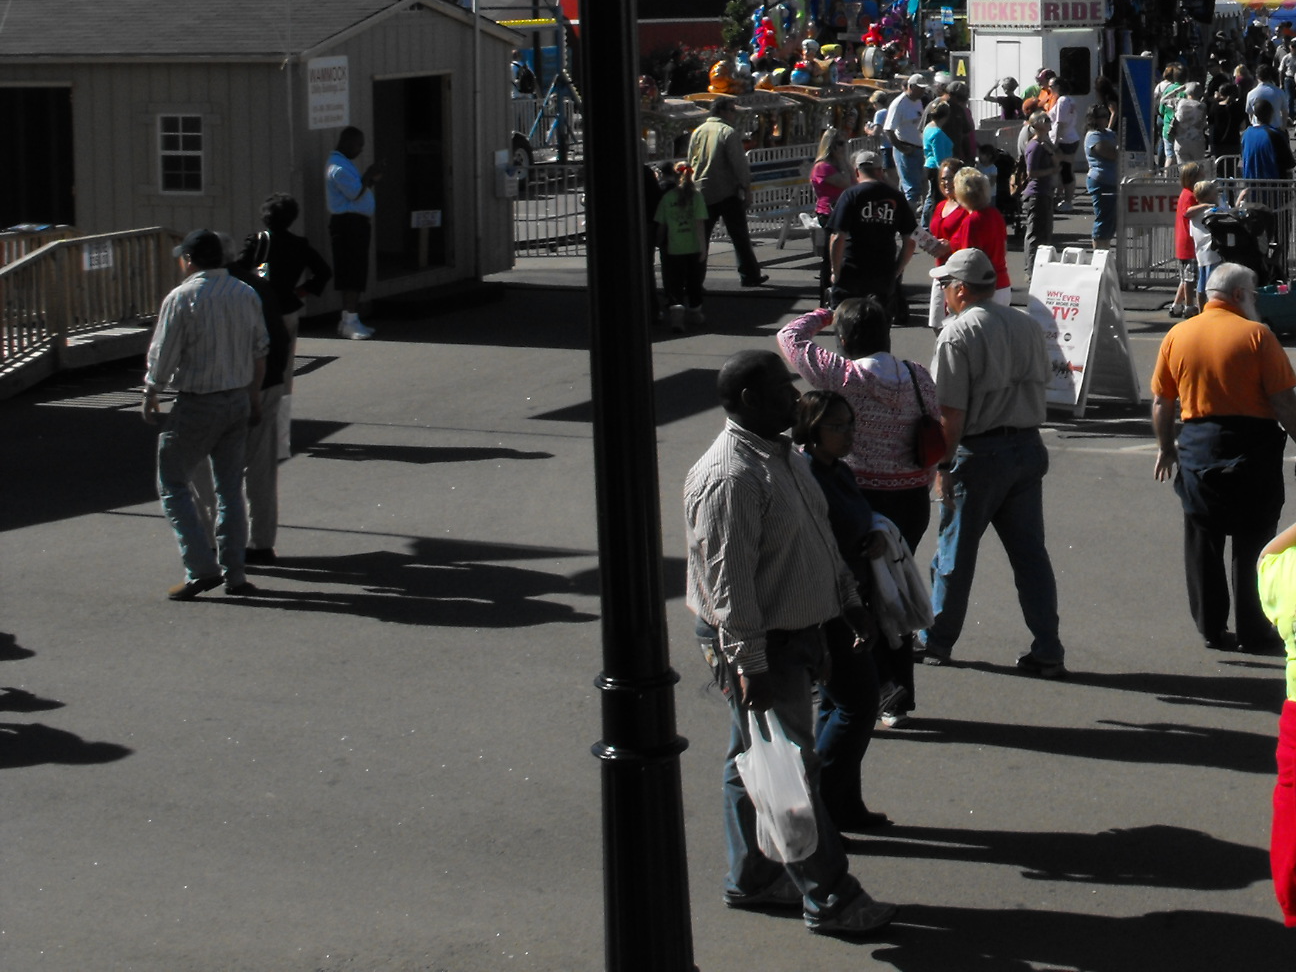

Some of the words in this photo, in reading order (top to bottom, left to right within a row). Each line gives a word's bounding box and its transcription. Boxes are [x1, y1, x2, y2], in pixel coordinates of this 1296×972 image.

[972, 2, 1038, 21] TICKETS
[1044, 2, 1102, 20] RIDE
[861, 201, 895, 221] dish
[1128, 195, 1180, 212] ENTE
[1062, 295, 1080, 303] EVER
[1052, 306, 1079, 321] TV?
